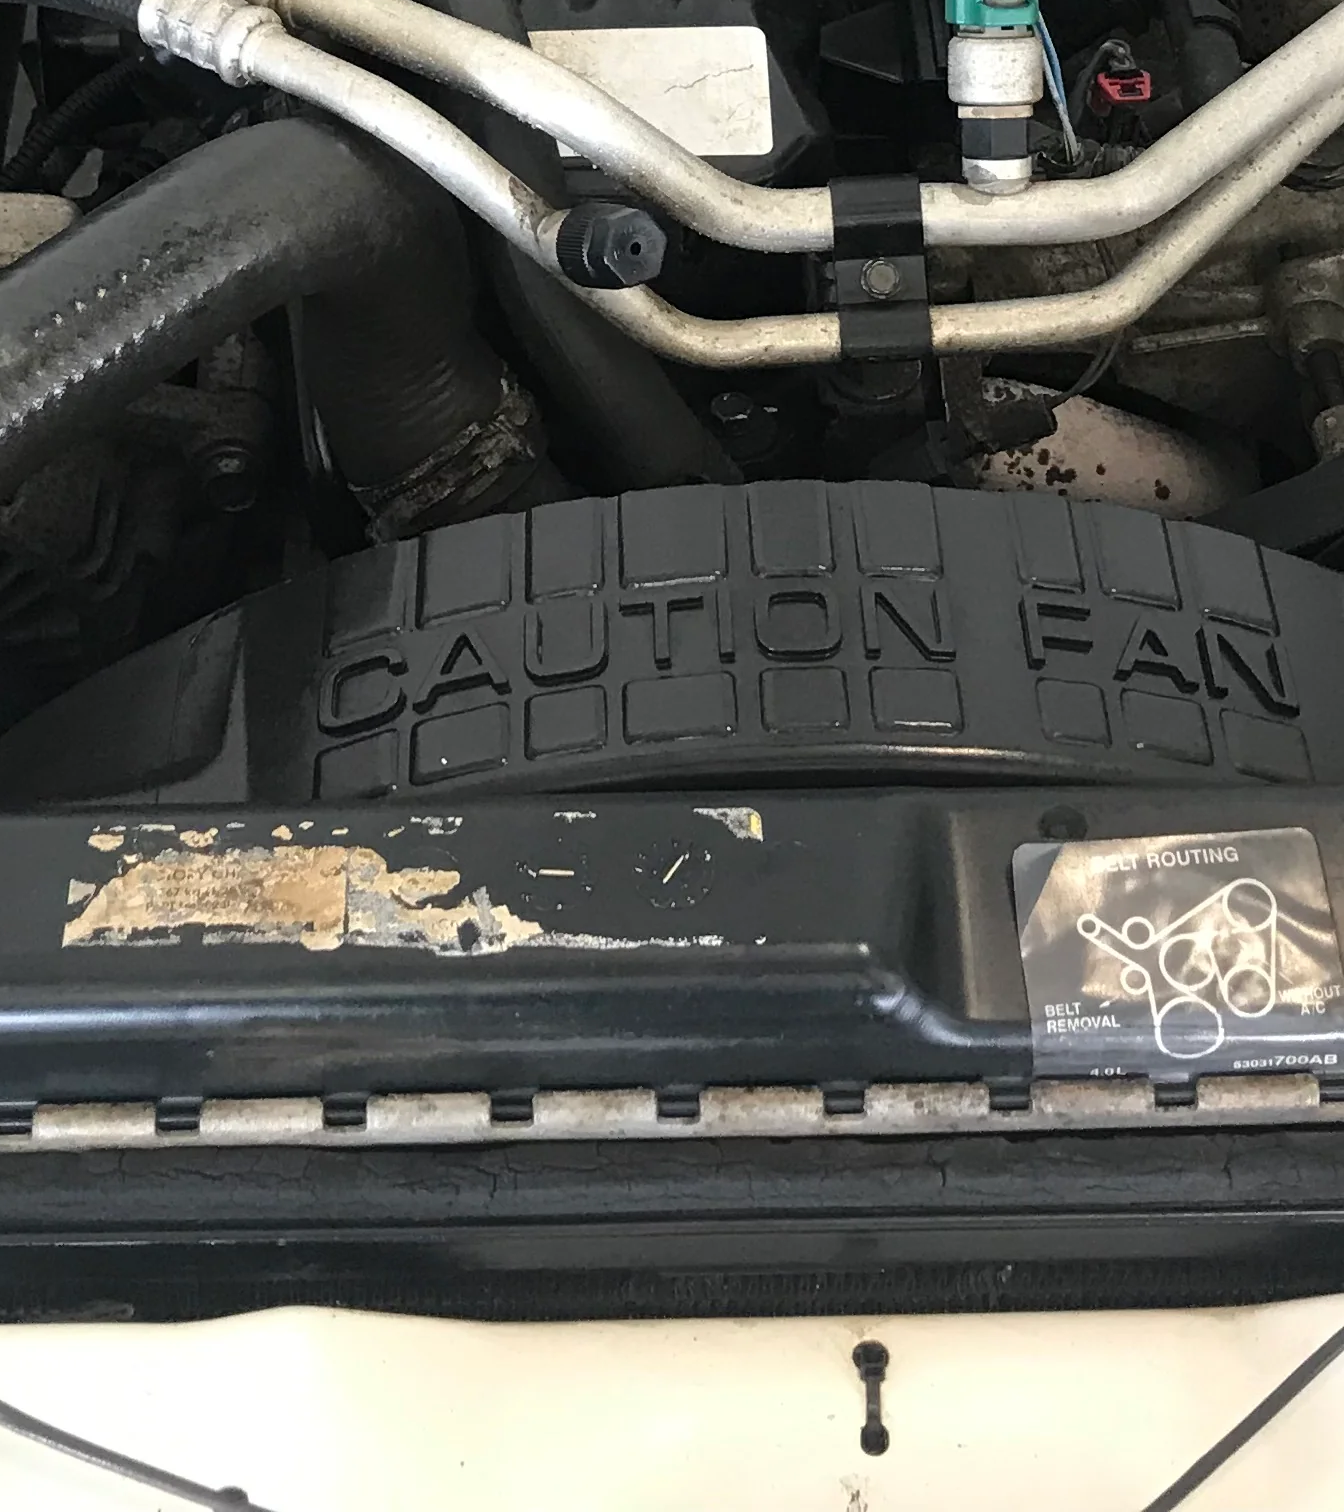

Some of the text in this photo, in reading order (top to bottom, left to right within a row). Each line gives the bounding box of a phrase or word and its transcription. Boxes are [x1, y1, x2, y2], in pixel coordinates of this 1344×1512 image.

[317, 589, 1301, 737] CAUTION FAN
[1146, 846, 1239, 869] ROUTING
[1278, 985, 1341, 1004] WHOUT
[1045, 1002, 1081, 1018] BELT
[1301, 1000, 1326, 1016] A/C
[1047, 1014, 1121, 1034] REMOVAL
